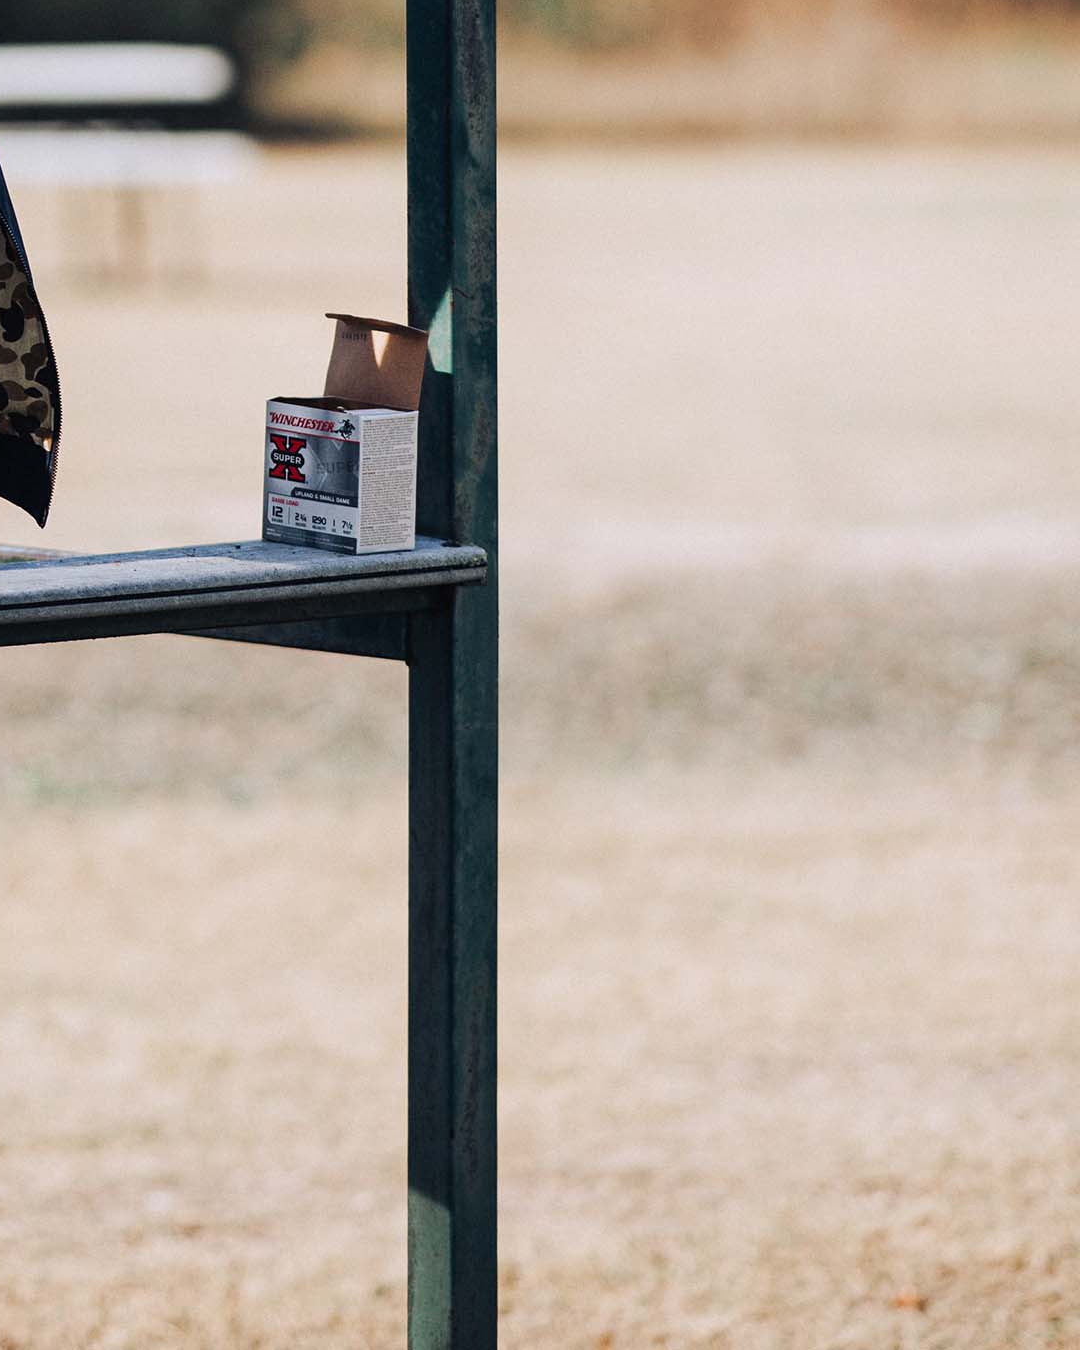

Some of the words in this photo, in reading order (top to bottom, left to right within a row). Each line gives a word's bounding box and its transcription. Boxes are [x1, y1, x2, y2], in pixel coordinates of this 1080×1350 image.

[270, 412, 335, 432] WINCHESTER
[269, 434, 307, 483] X
[273, 452, 302, 464] SUPER
[336, 497, 350, 505] GAME
[272, 506, 283, 518] 12
[312, 516, 327, 526] 1290
